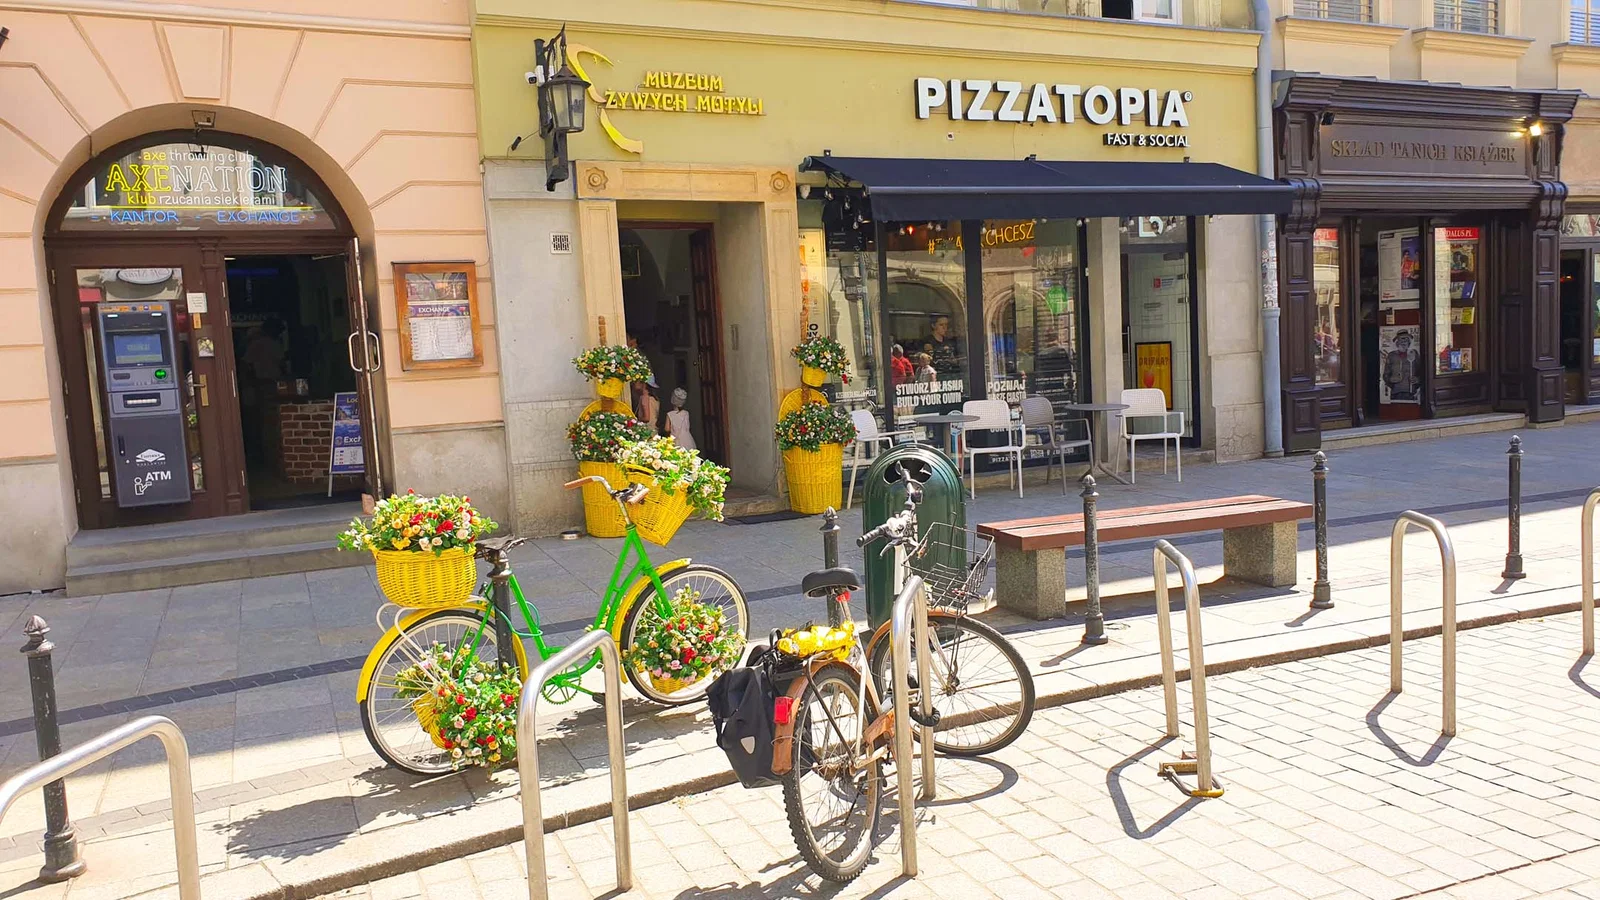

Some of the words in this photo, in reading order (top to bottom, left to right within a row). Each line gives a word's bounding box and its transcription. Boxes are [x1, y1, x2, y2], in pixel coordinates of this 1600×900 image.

[643, 70, 725, 92] MUZEUM
[604, 89, 688, 112] ŻYWYCH
[696, 95, 764, 115] MOTYLI
[917, 77, 1190, 127] PIZZATOPIA
[1107, 132, 1134, 146] FAST
[1138, 134, 1147, 146] &
[1150, 134, 1191, 148] SOCIAL
[143, 151, 167, 161] axe
[170, 149, 226, 165] throwing
[228, 150, 255, 162] club
[1331, 139, 1384, 157] SKŁAD
[1390, 141, 1447, 161] TANICH
[1453, 142, 1516, 166] KSIĄŻEK
[105, 163, 287, 193] AXENATION
[127, 191, 156, 205] klub
[159, 193, 213, 205] rzucania
[110, 210, 179, 223] KANTOR
[217, 210, 299, 223] EXCHANGE
[986, 221, 1035, 246] CHCESZ
[418, 306, 450, 314] EXCHANGE
[895, 380, 929, 396] STWÓRZ
[929, 379, 963, 393] WŁASNĄ
[987, 379, 1026, 393] POZNAJ
[897, 395, 919, 408] BUILD
[920, 393, 941, 406] YOUR
[942, 392, 962, 404] OWN
[145, 470, 172, 481] ATM
